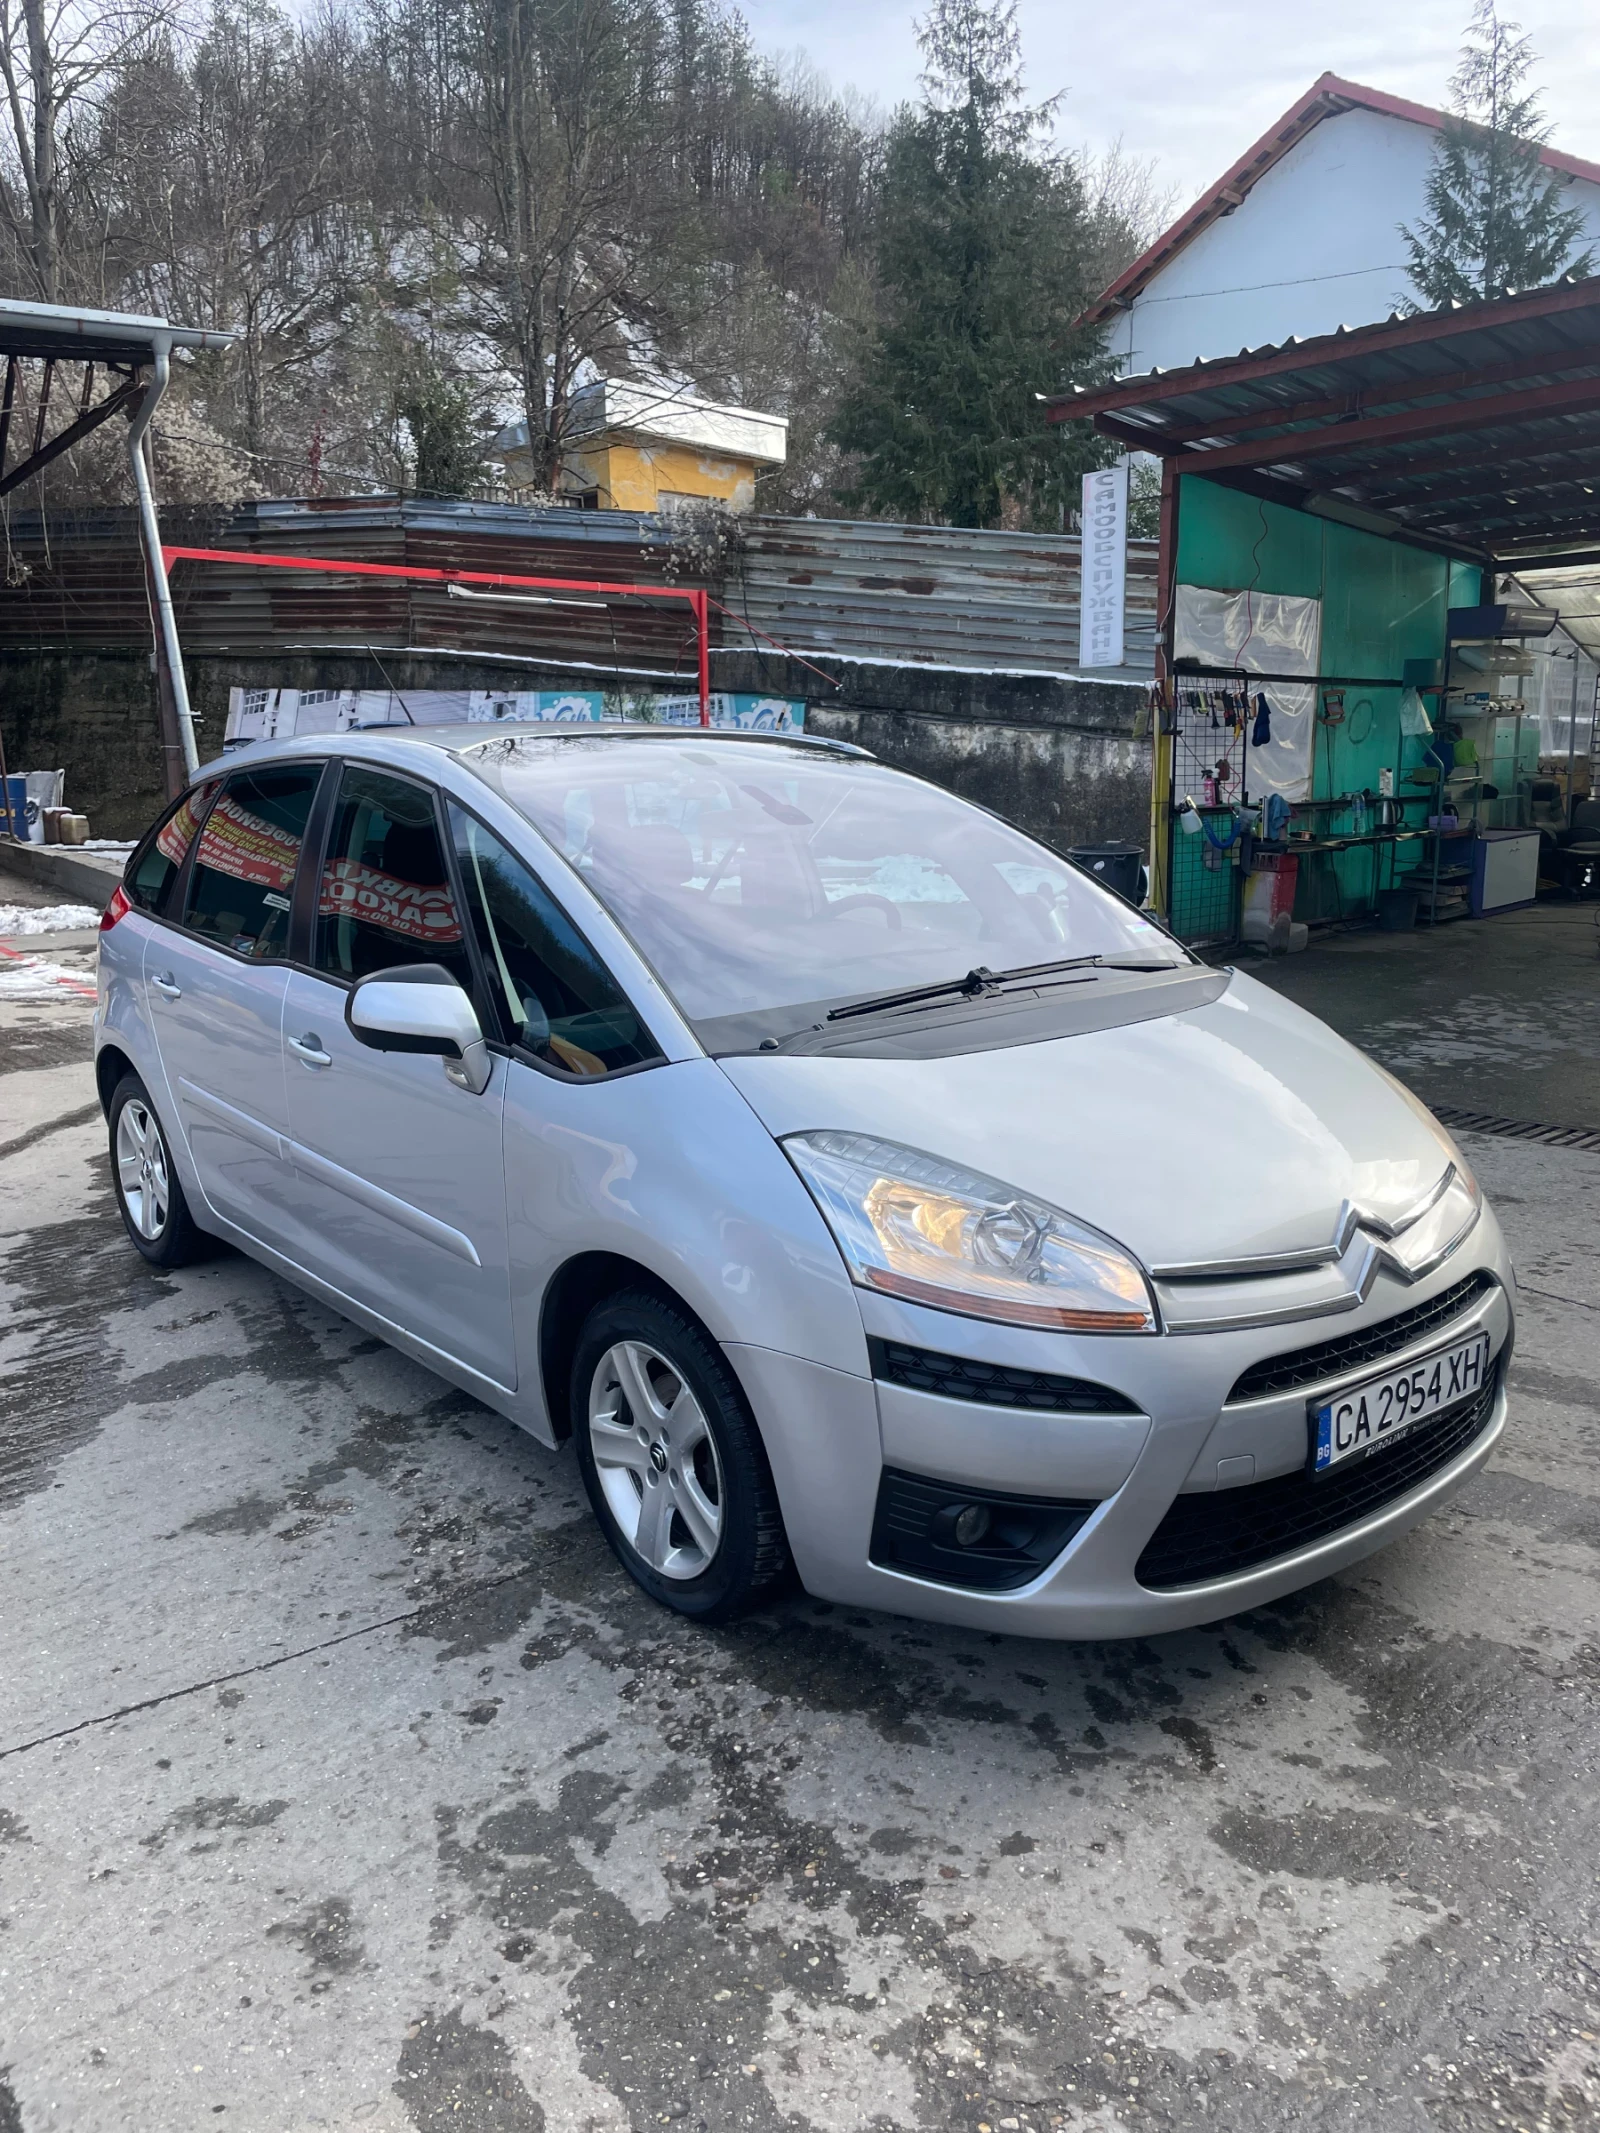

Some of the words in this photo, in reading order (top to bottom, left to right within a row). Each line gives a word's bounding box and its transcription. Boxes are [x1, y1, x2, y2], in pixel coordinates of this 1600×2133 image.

[1336, 1395, 1371, 1451] CA
[1377, 1360, 1442, 1433] 2954
[1446, 1343, 1482, 1399] XH
[1317, 1443, 1330, 1461] BG
